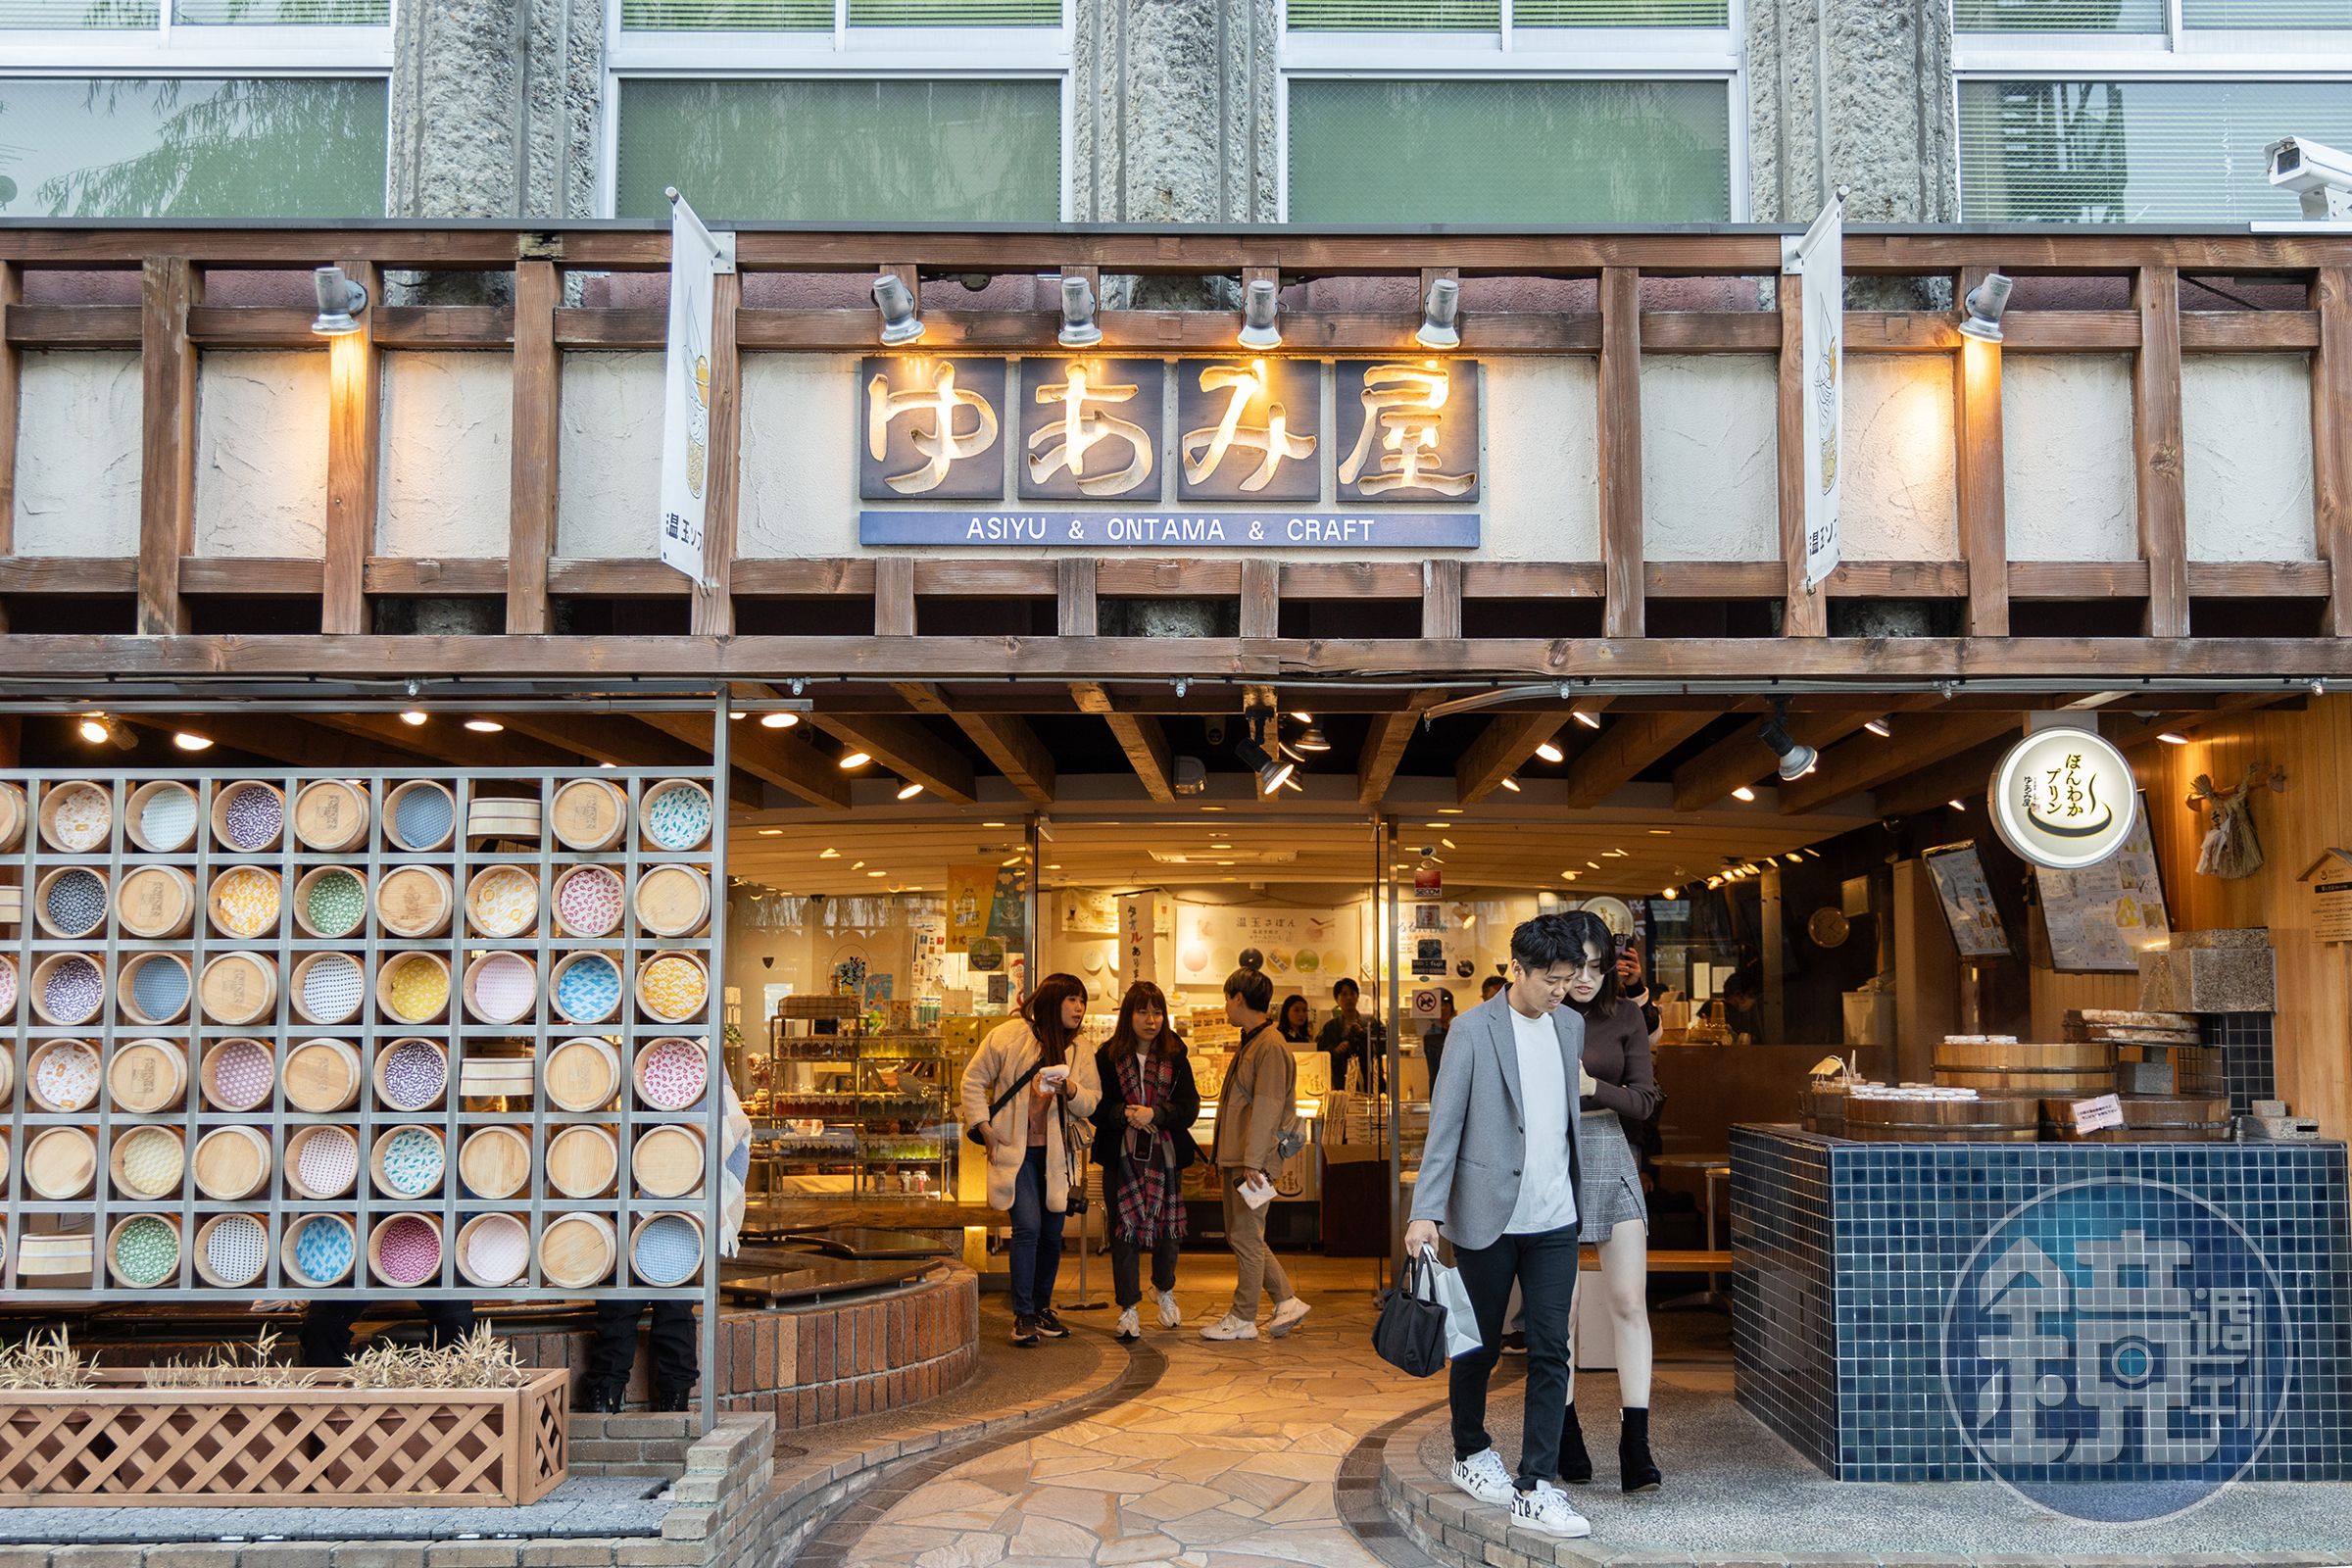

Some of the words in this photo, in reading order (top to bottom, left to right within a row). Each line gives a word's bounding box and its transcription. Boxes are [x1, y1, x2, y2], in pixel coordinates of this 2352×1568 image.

[868, 360, 1477, 497] ゆあみ屋
[965, 516, 1048, 541] ASIYU
[1068, 519, 1085, 540] &
[1106, 516, 1226, 542] ONTAMA
[1248, 519, 1265, 541] &
[1286, 517, 1375, 543] CRAFT
[1809, 518, 1838, 557] 温玉ソ
[2046, 768, 2062, 814] プリン
[2065, 754, 2083, 817] ほんわか
[1127, 905, 1144, 983] タオルありま
